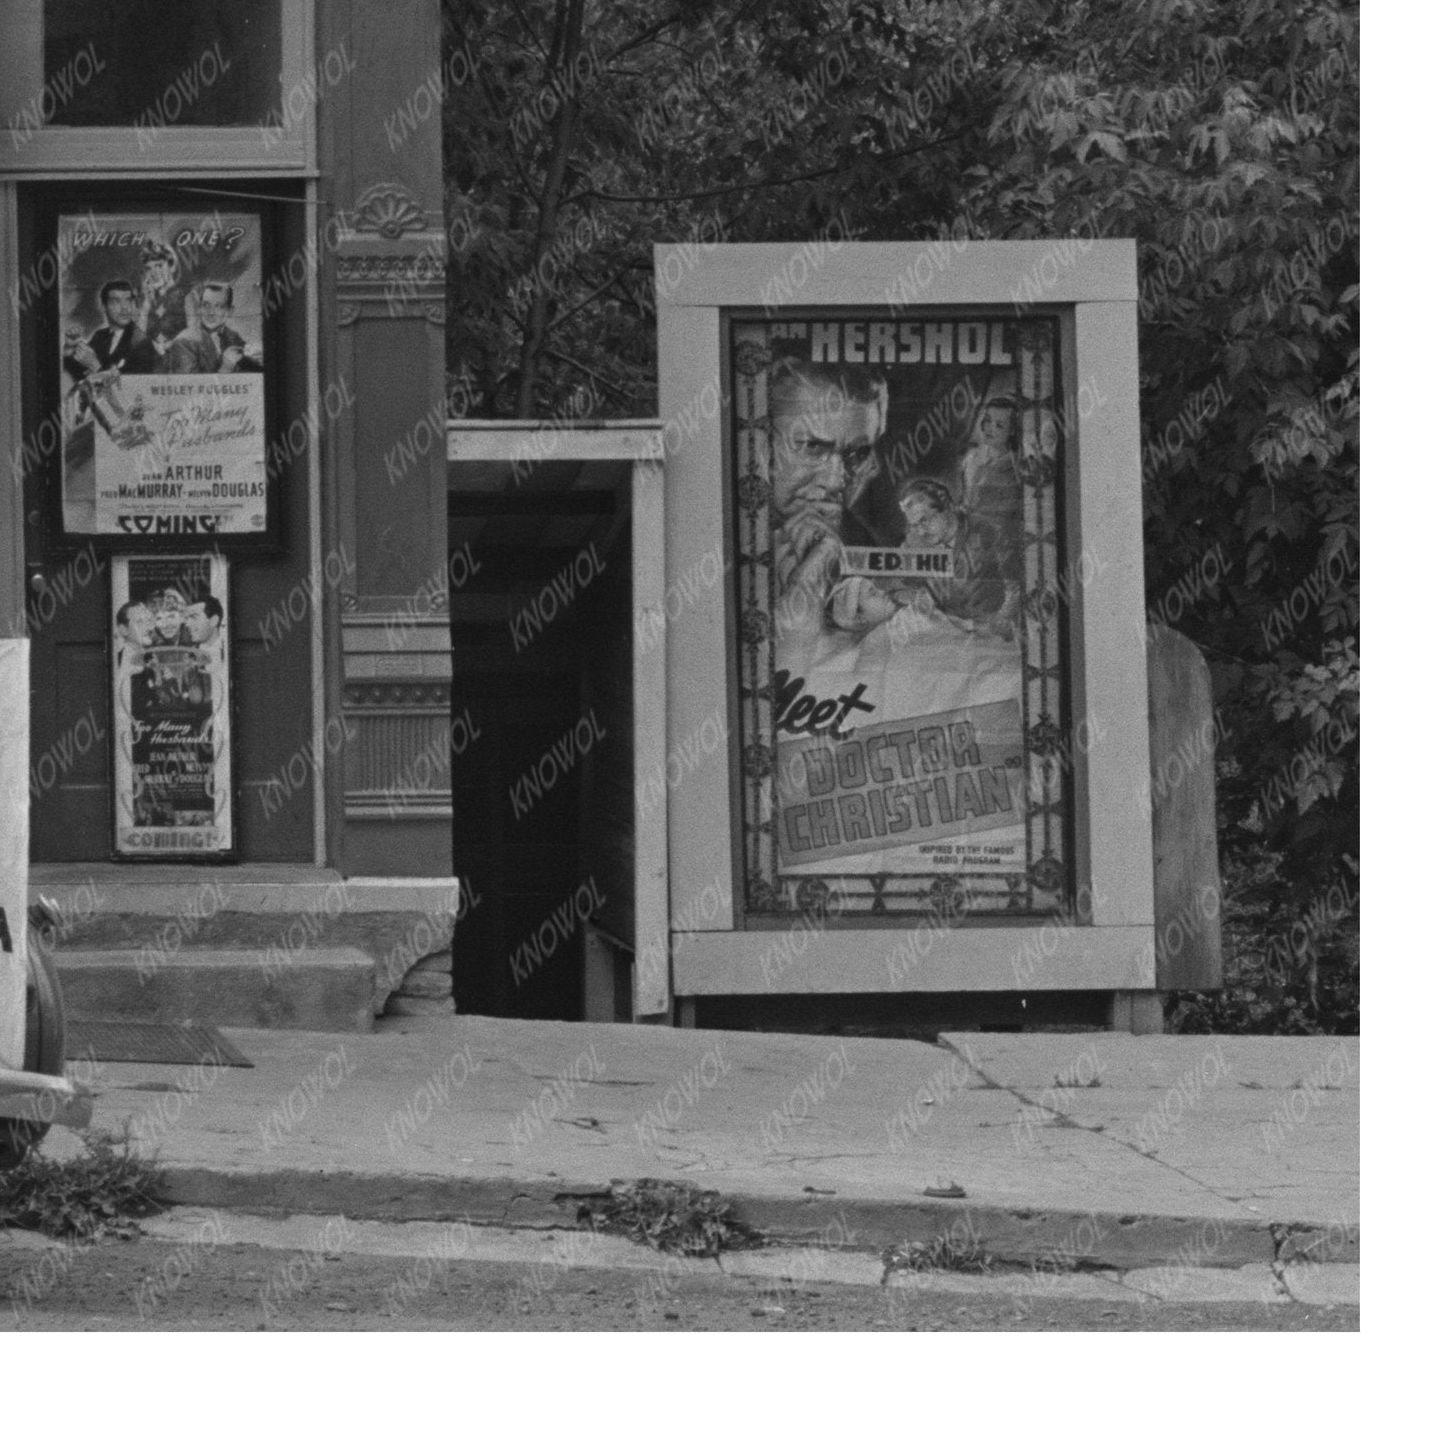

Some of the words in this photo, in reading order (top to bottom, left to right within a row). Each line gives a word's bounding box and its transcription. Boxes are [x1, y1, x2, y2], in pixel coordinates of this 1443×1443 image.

[72, 231, 146, 248] WHICH
[176, 226, 245, 250] ONE?
[812, 322, 1012, 365] HERSHOL
[150, 384, 194, 396] WESLEY
[165, 464, 223, 481] ARTHUR
[212, 481, 265, 498] DOUGLAS
[802, 721, 981, 797] DOCTOR
